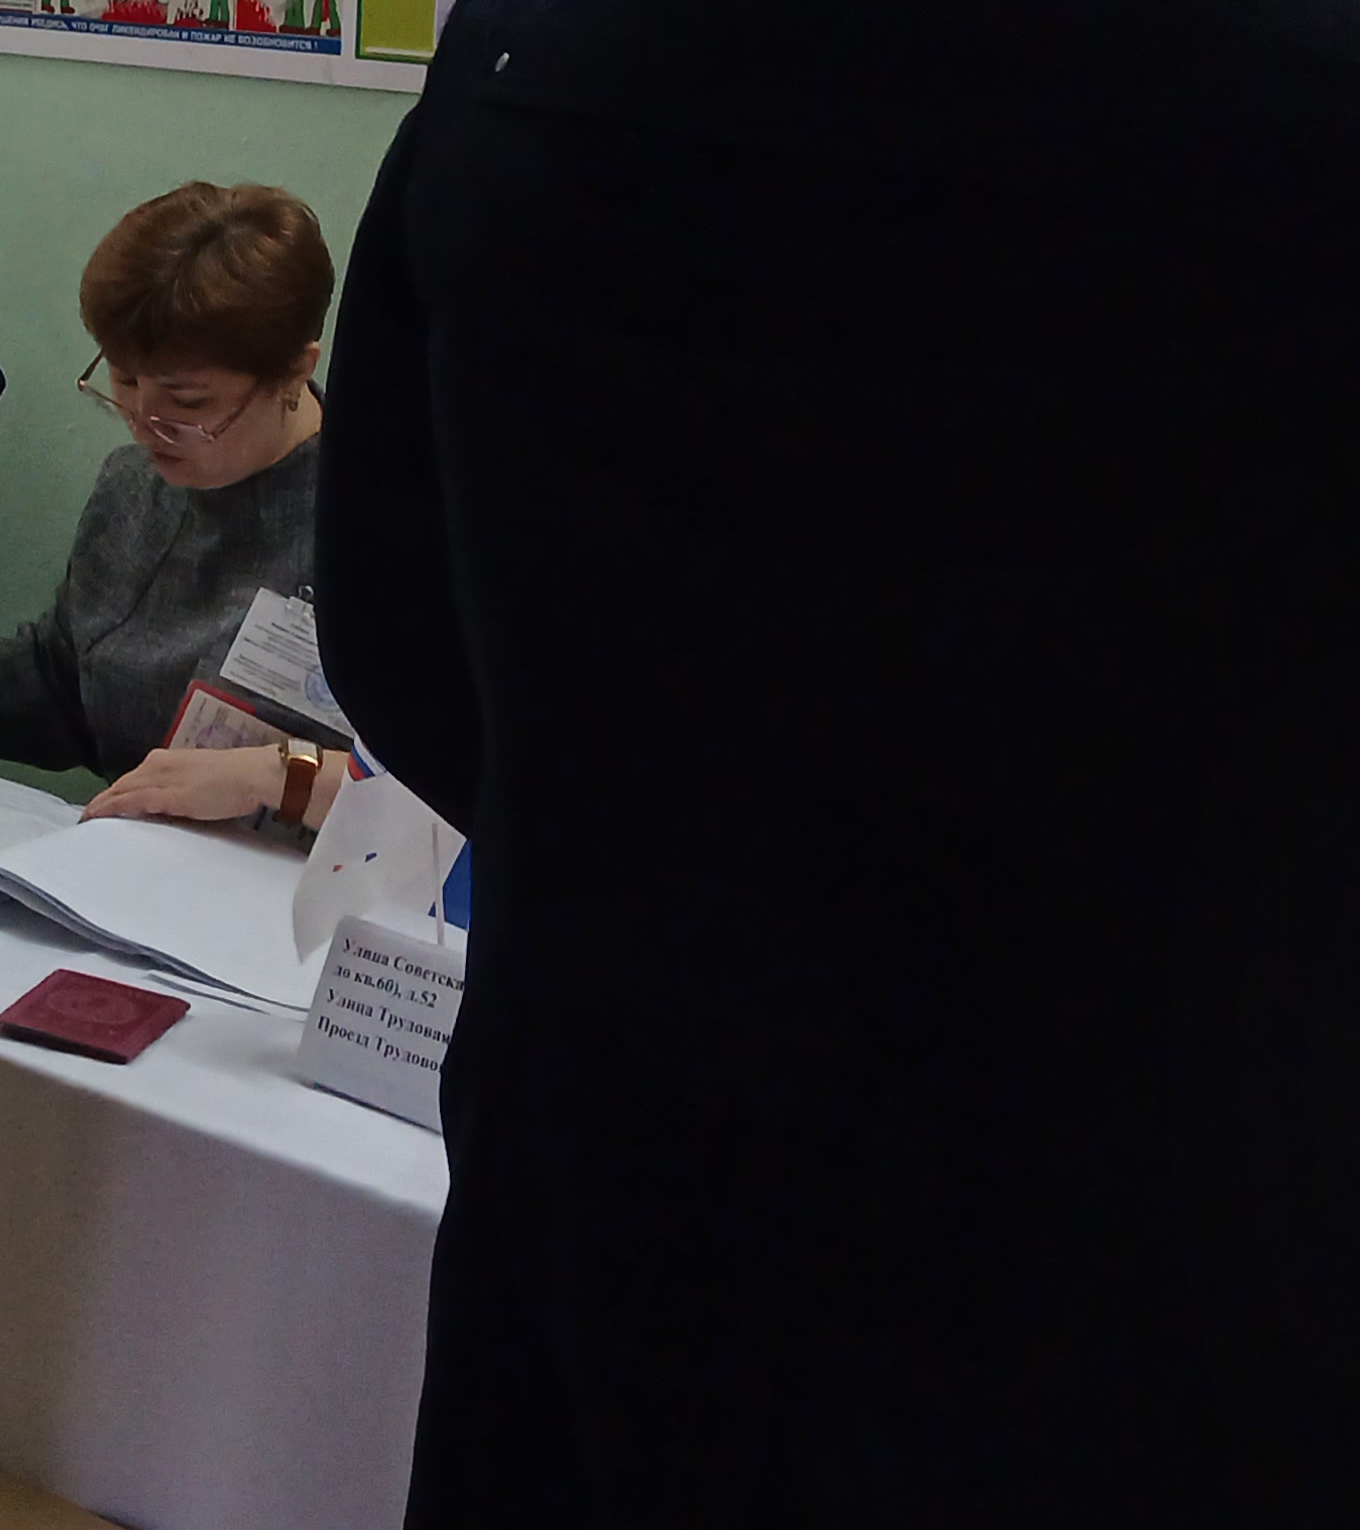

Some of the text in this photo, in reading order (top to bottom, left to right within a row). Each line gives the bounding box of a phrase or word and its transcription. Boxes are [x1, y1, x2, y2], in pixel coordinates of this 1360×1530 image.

[343, 938, 390, 967] Улица
[354, 973, 402, 999] кв.60),
[327, 988, 374, 1018] Улица
[317, 1016, 442, 1073] Проезд Трудово
